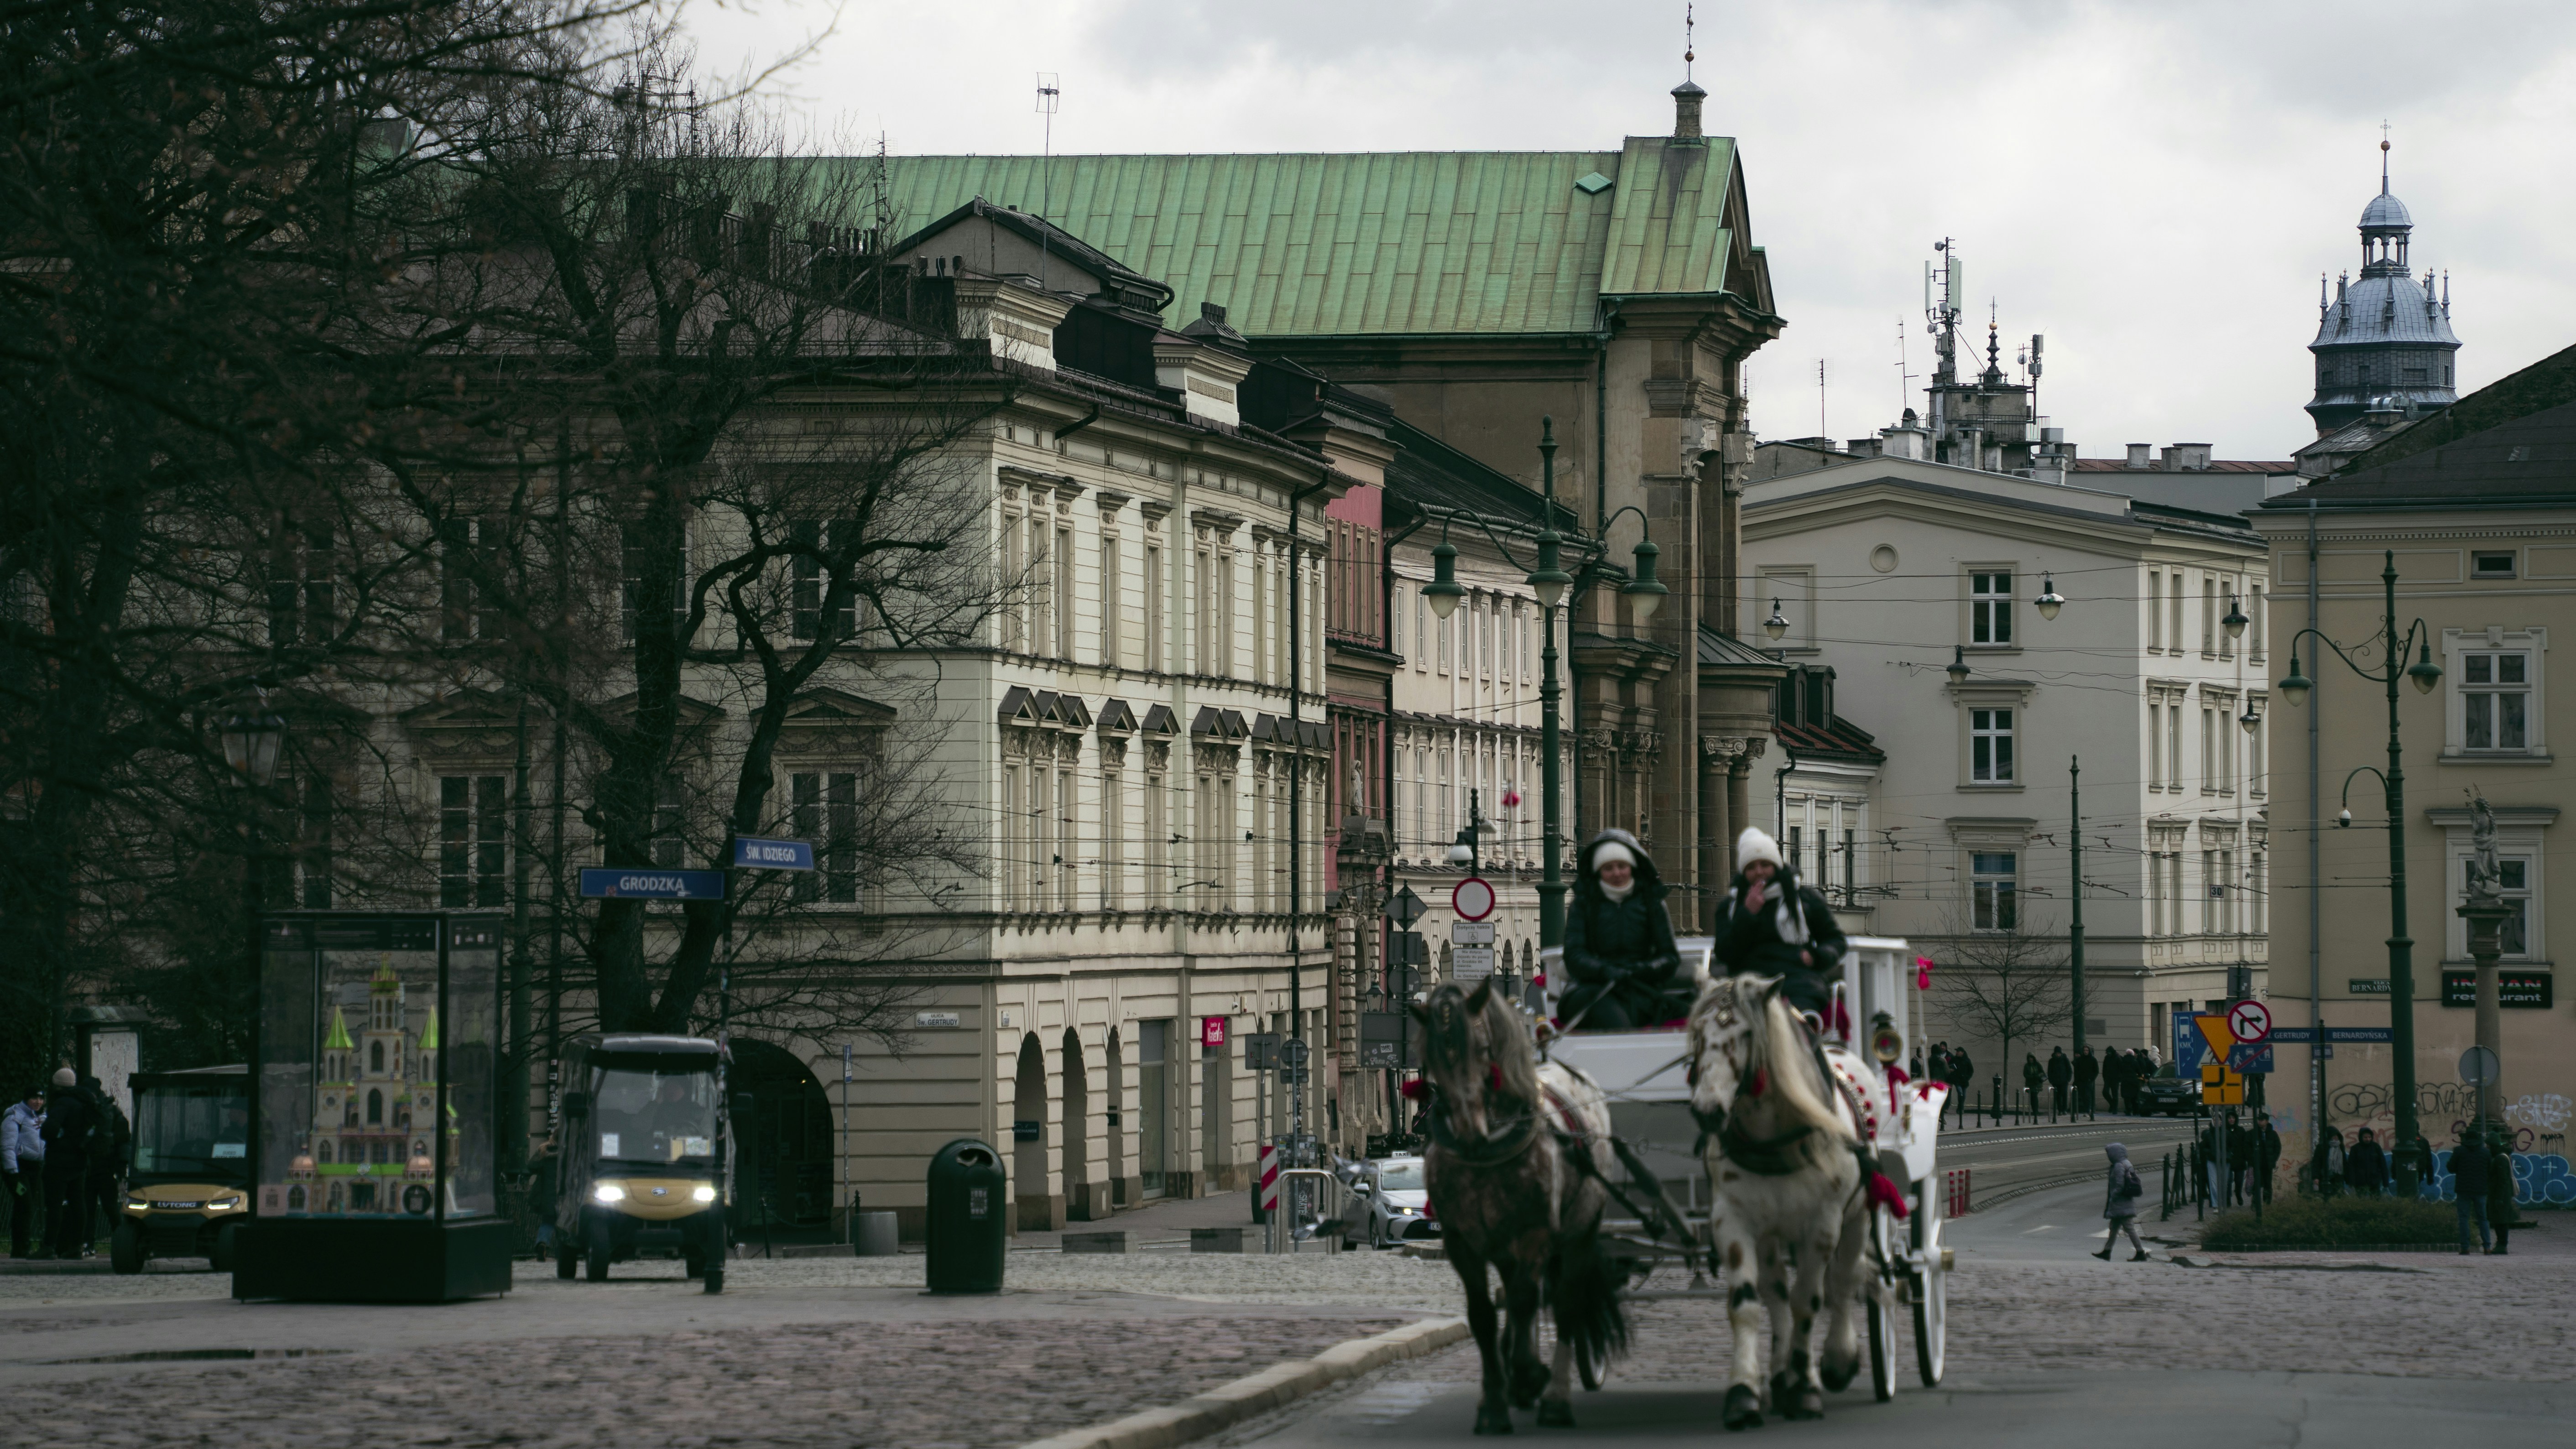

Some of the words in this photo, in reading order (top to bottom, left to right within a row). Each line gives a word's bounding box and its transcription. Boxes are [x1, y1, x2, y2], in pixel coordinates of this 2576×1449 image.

[746, 842, 761, 860] ŚW.
[763, 847, 796, 862] IDZIEGO
[620, 876, 685, 891] GRODZKA
[2452, 978, 2542, 991] INIAN
[2453, 993, 2542, 1002] resurant
